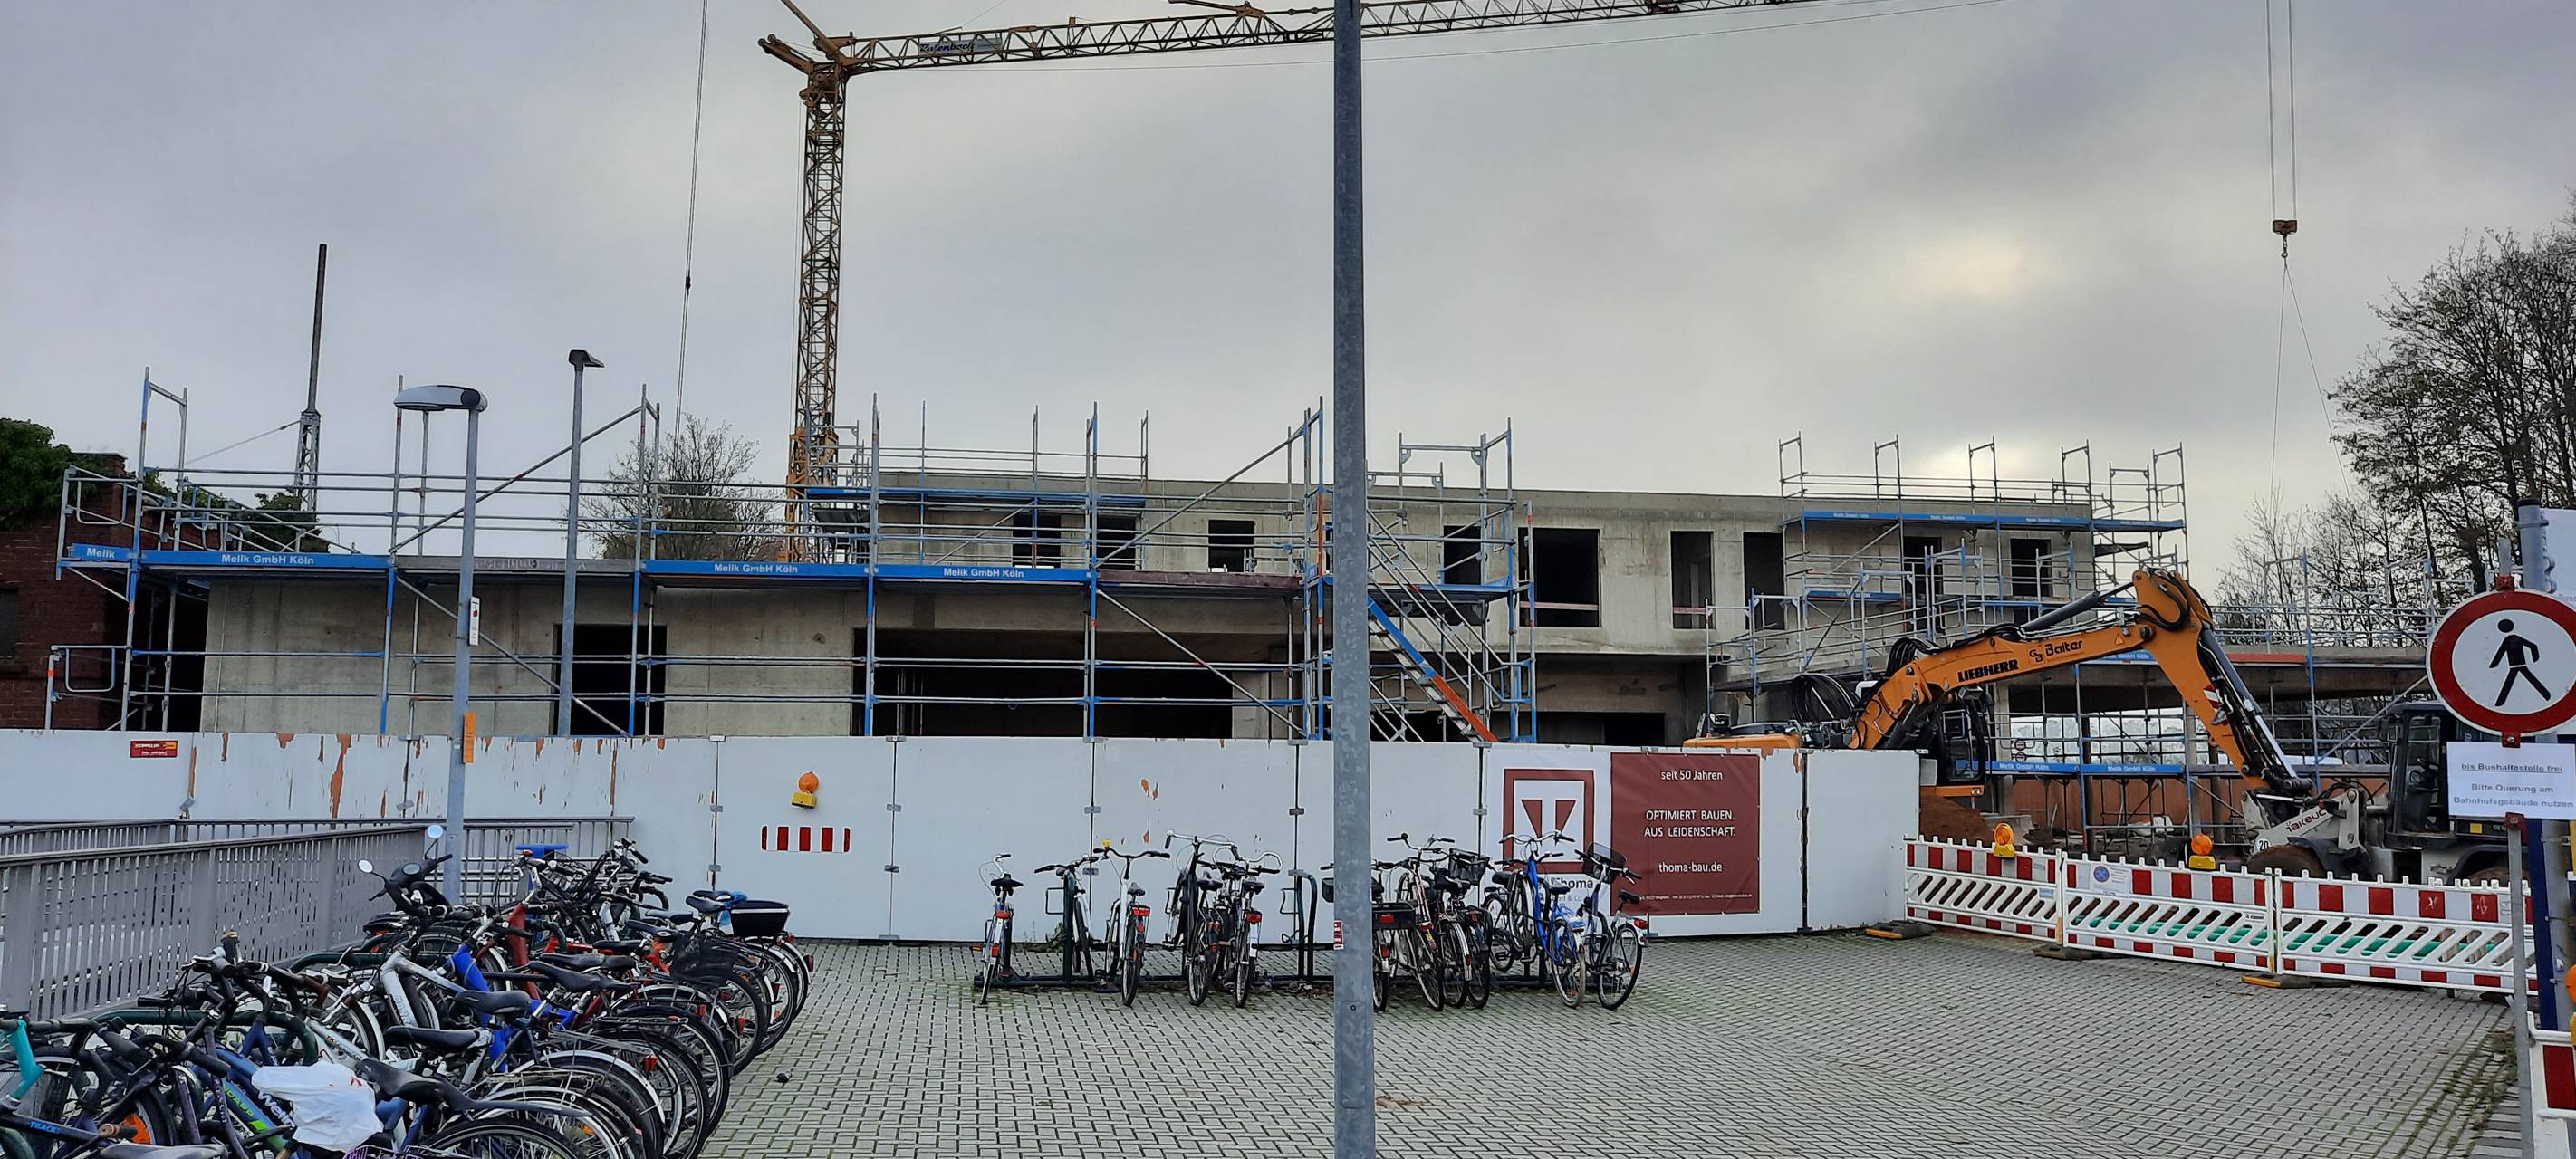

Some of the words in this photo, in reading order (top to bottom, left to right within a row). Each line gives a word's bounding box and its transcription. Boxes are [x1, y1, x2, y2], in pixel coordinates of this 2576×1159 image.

[86, 547, 116, 559] Melik
[221, 554, 250, 564] Melik
[253, 554, 286, 564] GmbH
[289, 555, 315, 565] Köln
[714, 563, 739, 572] Melik
[742, 564, 773, 573] GmbH
[775, 564, 798, 573] Köln
[943, 567, 968, 577] Melik
[970, 568, 1000, 577] GmbH
[1002, 569, 1024, 578] Köln
[2044, 639, 2083, 656] Balter
[1957, 658, 2020, 683] LIEBHERR
[2478, 763, 2544, 772] Bushaltestelle
[1661, 770, 1678, 780] seit
[1679, 770, 1691, 780] 50
[1694, 770, 1723, 780] Jahren
[2495, 784, 2536, 793] Querung
[2453, 797, 2539, 807] Bahnhofsgebäude
[1646, 809, 1697, 820] OPTIMIERT
[1701, 810, 1735, 820] BAUEN.
[1644, 827, 1663, 837] AUS
[1668, 827, 1736, 837] LEIDENSCHAFT.
[2258, 839, 2269, 851] 20
[1658, 861, 1723, 873] thoma-bau.de
